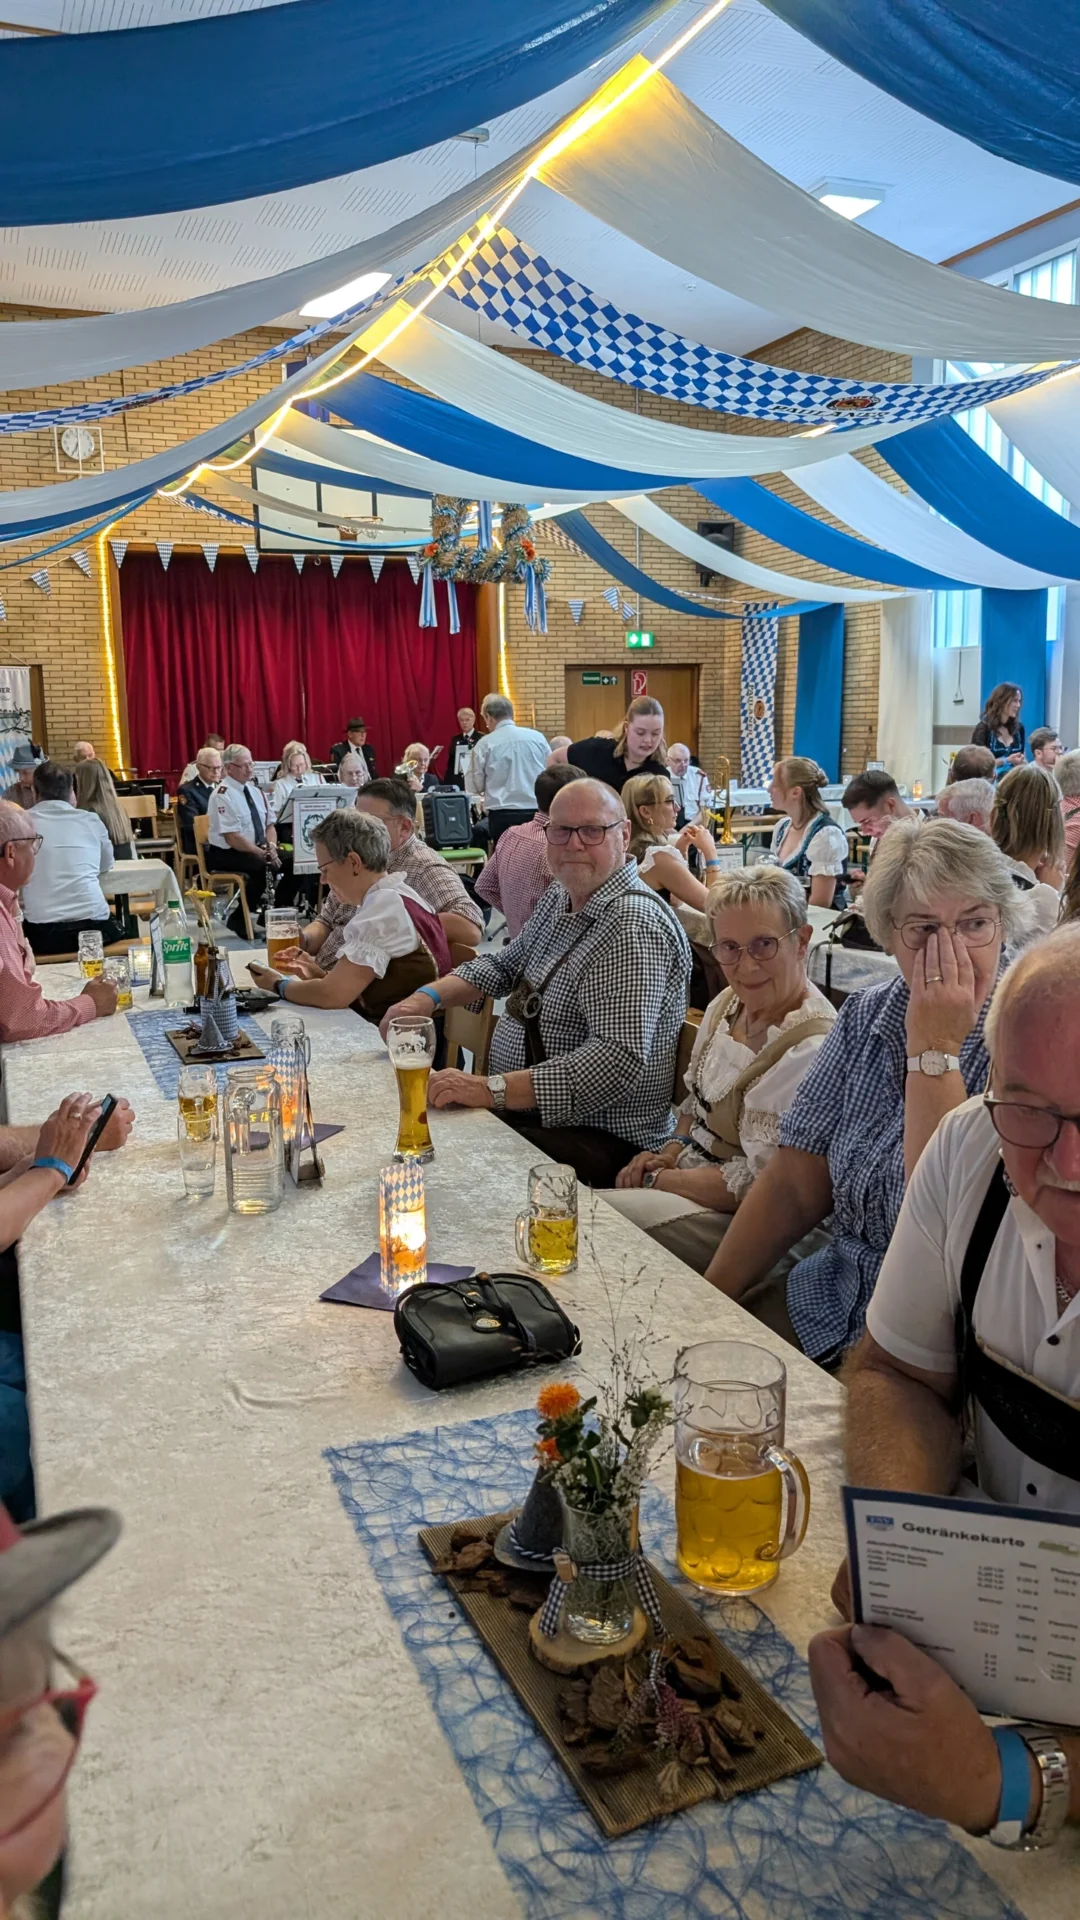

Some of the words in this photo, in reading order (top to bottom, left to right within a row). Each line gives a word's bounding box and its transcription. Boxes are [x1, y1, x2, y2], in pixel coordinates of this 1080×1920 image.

[768, 405, 890, 419] PAULANER
[163, 940, 189, 954] Sprite
[902, 1522, 1025, 1547] Getränkekarte
